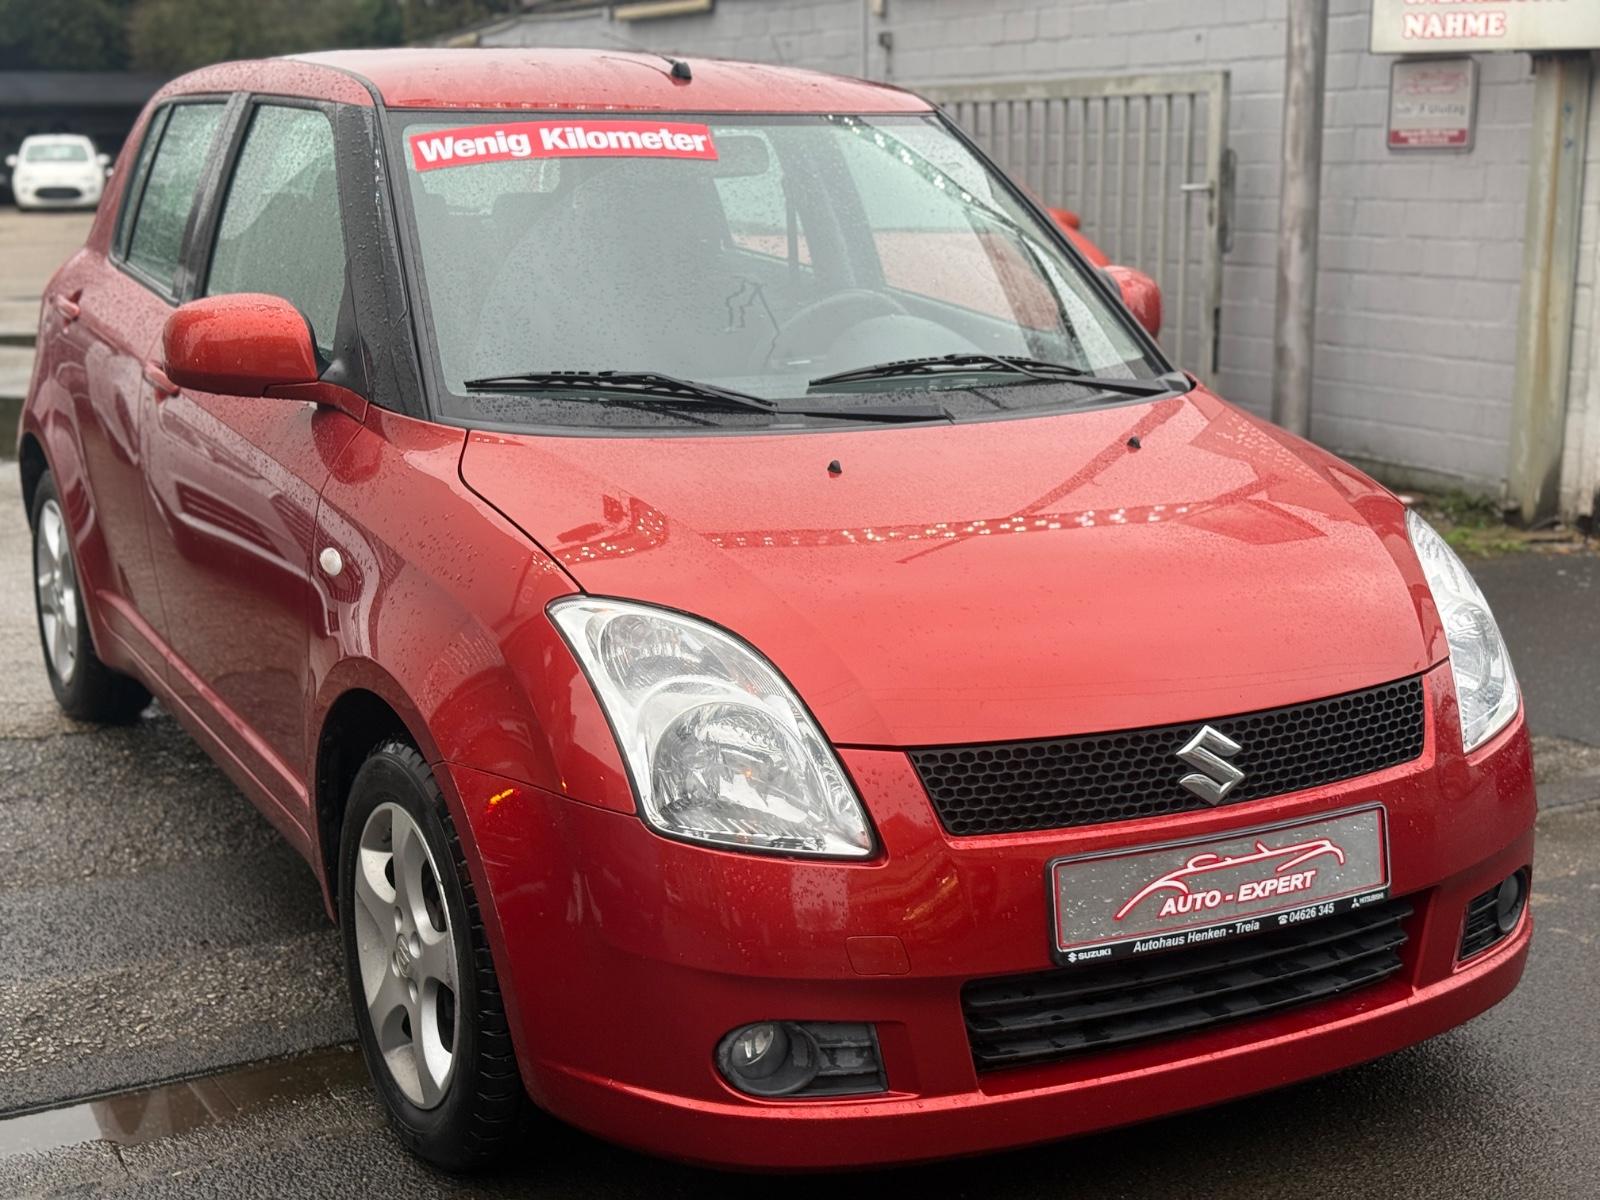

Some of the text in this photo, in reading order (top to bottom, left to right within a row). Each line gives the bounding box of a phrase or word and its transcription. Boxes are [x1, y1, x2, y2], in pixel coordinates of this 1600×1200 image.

[1403, 12, 1505, 38] NAHME
[417, 127, 707, 162] Wenig Kilometer
[1158, 889, 1222, 917] AUTO
[1237, 870, 1317, 903] EXPERT
[1289, 903, 1334, 922] 04626 345
[1133, 936, 1185, 953] Autohaus
[1187, 927, 1226, 943] Henken
[1235, 920, 1260, 934] Treia
[1078, 948, 1112, 960] SUZUKI
